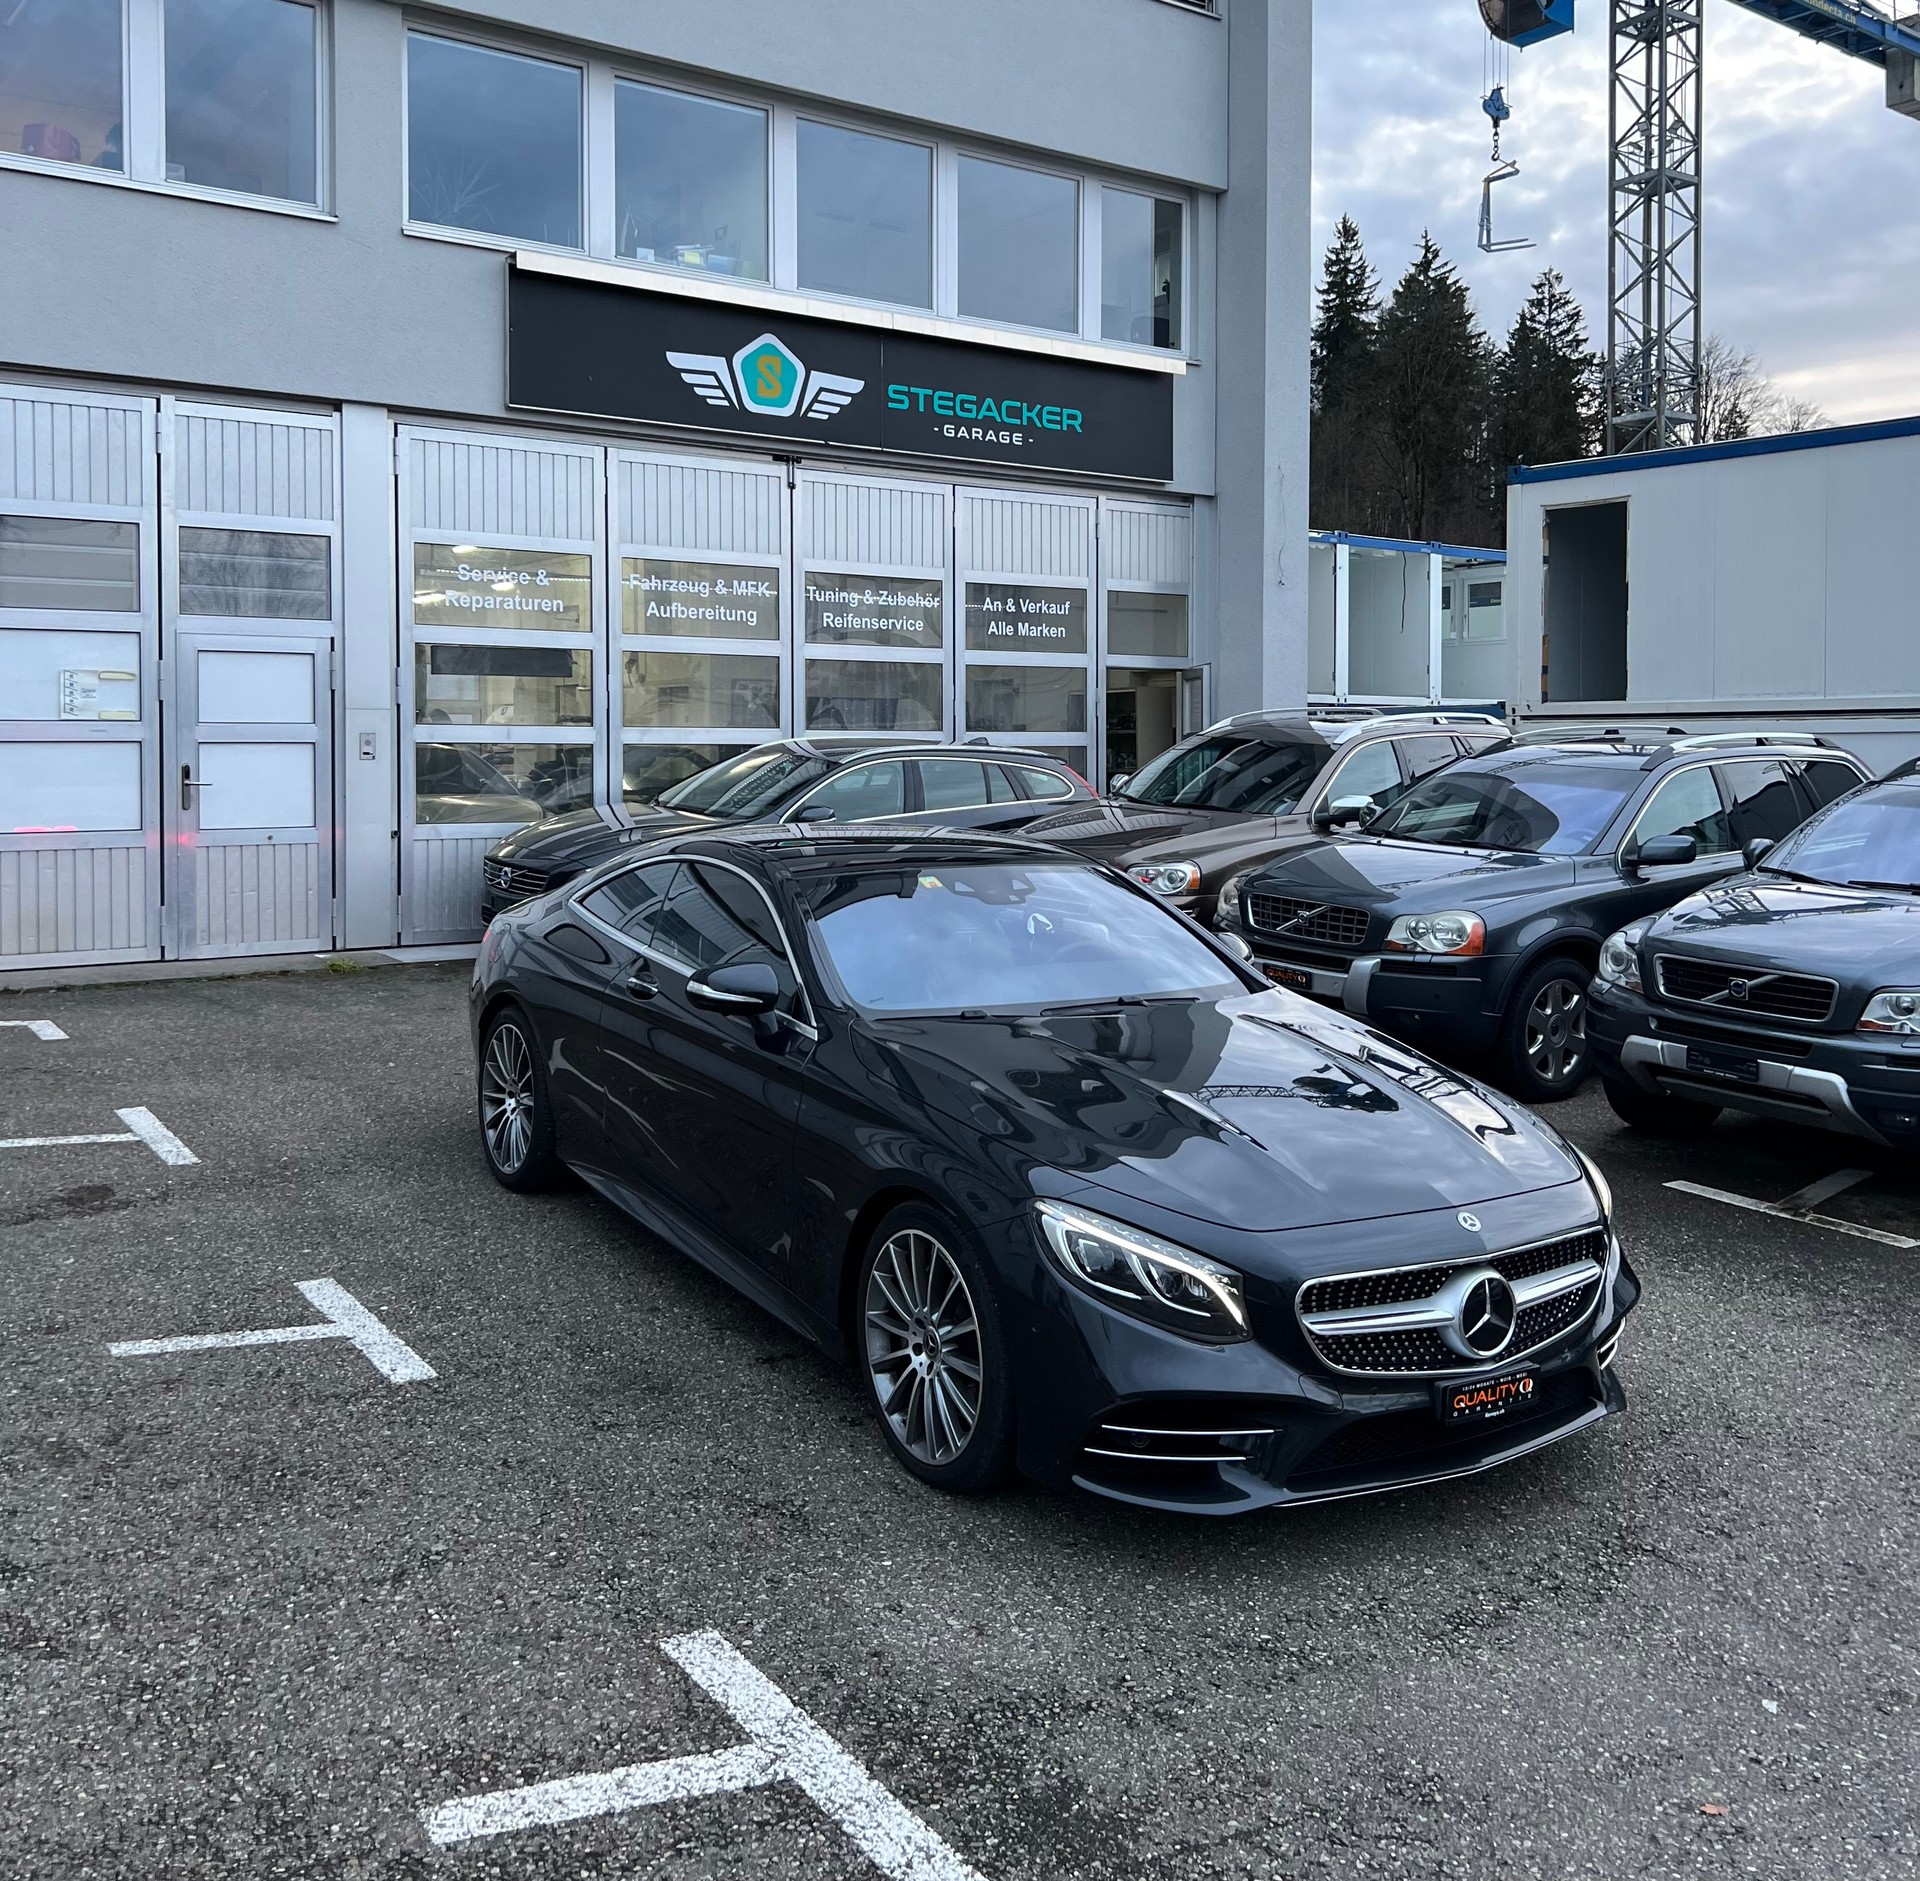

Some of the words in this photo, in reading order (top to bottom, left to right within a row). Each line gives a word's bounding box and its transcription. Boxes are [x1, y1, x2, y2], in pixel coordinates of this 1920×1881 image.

[887, 384, 1083, 433] STEGACKER
[943, 424, 1023, 446] GARAGE
[457, 564, 530, 585] Service
[536, 569, 550, 586] &
[629, 574, 710, 597] Fahrzeug
[715, 579, 730, 594] &
[733, 580, 770, 598] MFK
[444, 590, 564, 613] Reparaturen
[806, 585, 858, 607] Tuning
[863, 588, 875, 604] &
[878, 589, 940, 609] Zubehör
[982, 597, 1002, 612] An
[1005, 599, 1016, 613] &
[1019, 598, 1071, 615] Verkauf
[646, 601, 758, 626] Aufbereitung
[822, 612, 924, 632] Reifenservice
[988, 620, 1014, 636] Alle
[1017, 621, 1066, 638] Marken
